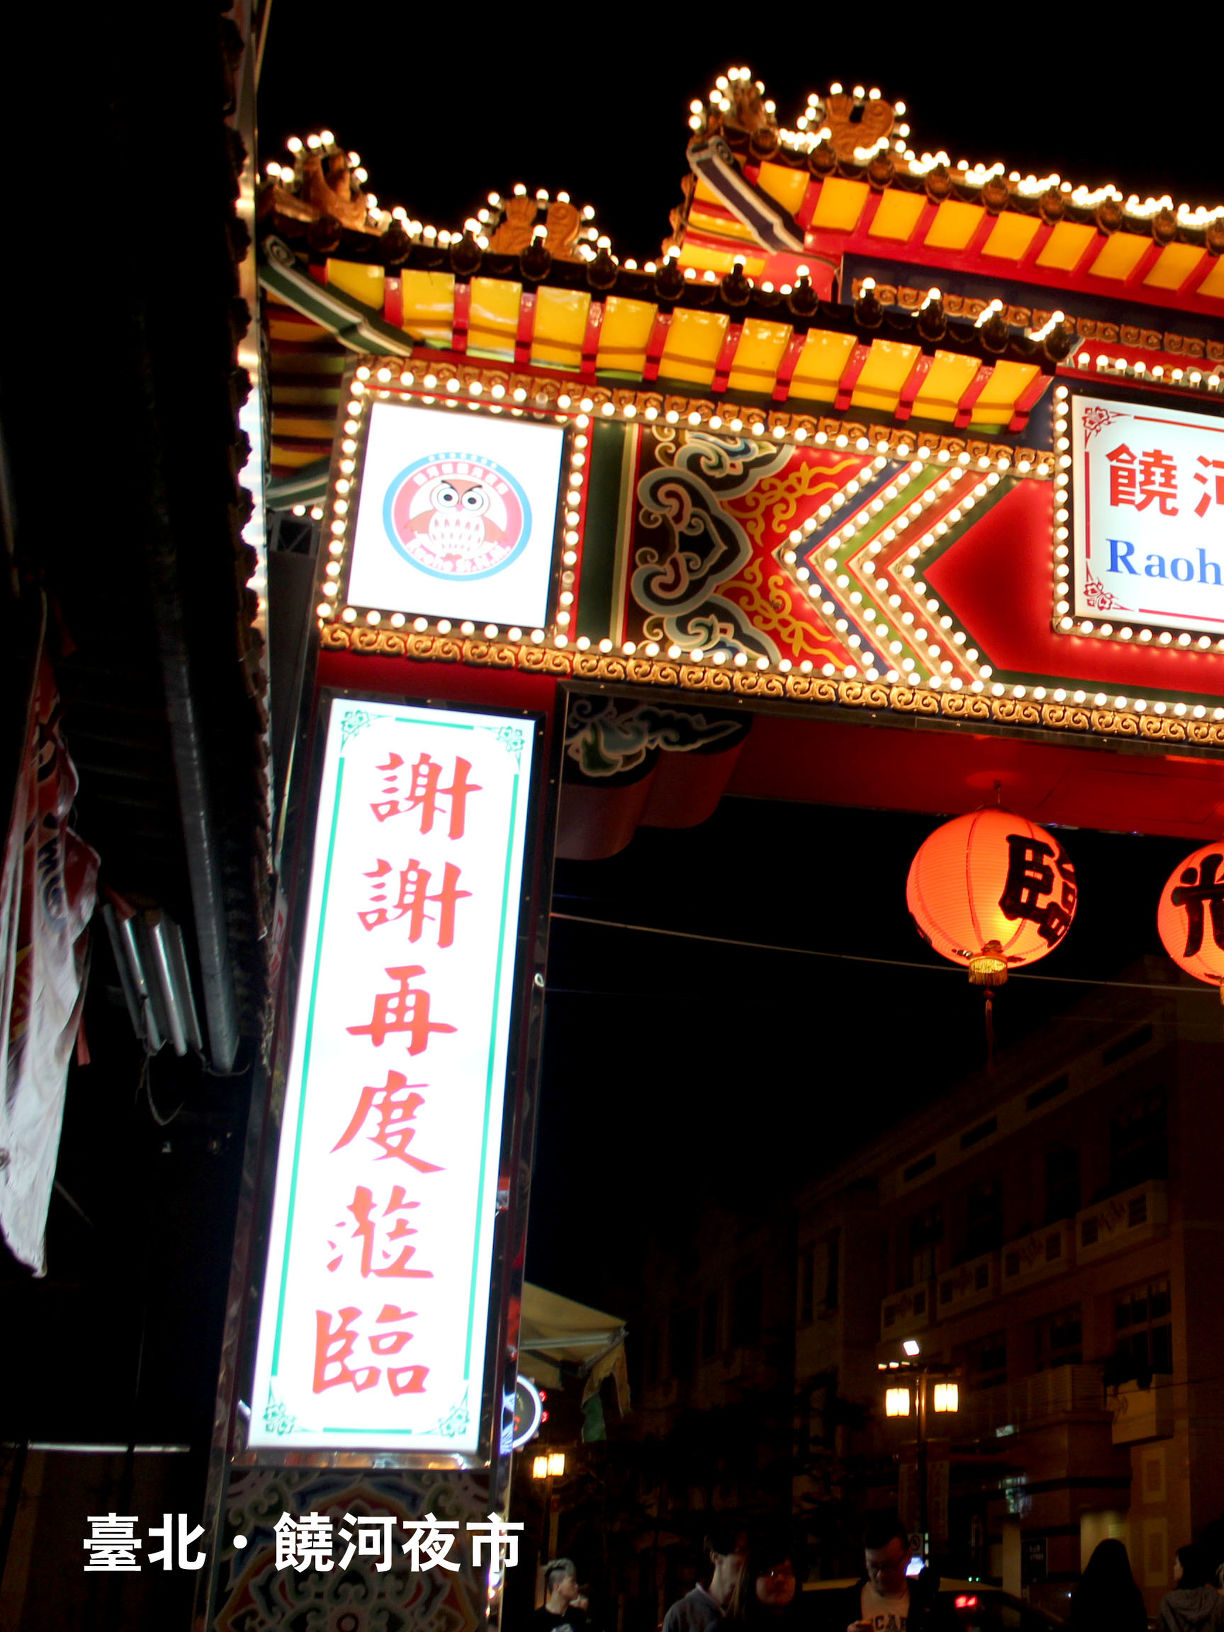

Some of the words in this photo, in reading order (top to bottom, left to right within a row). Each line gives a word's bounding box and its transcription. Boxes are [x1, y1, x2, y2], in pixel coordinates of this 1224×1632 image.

[313, 753, 483, 1397] 謝謝再度蒞臨
